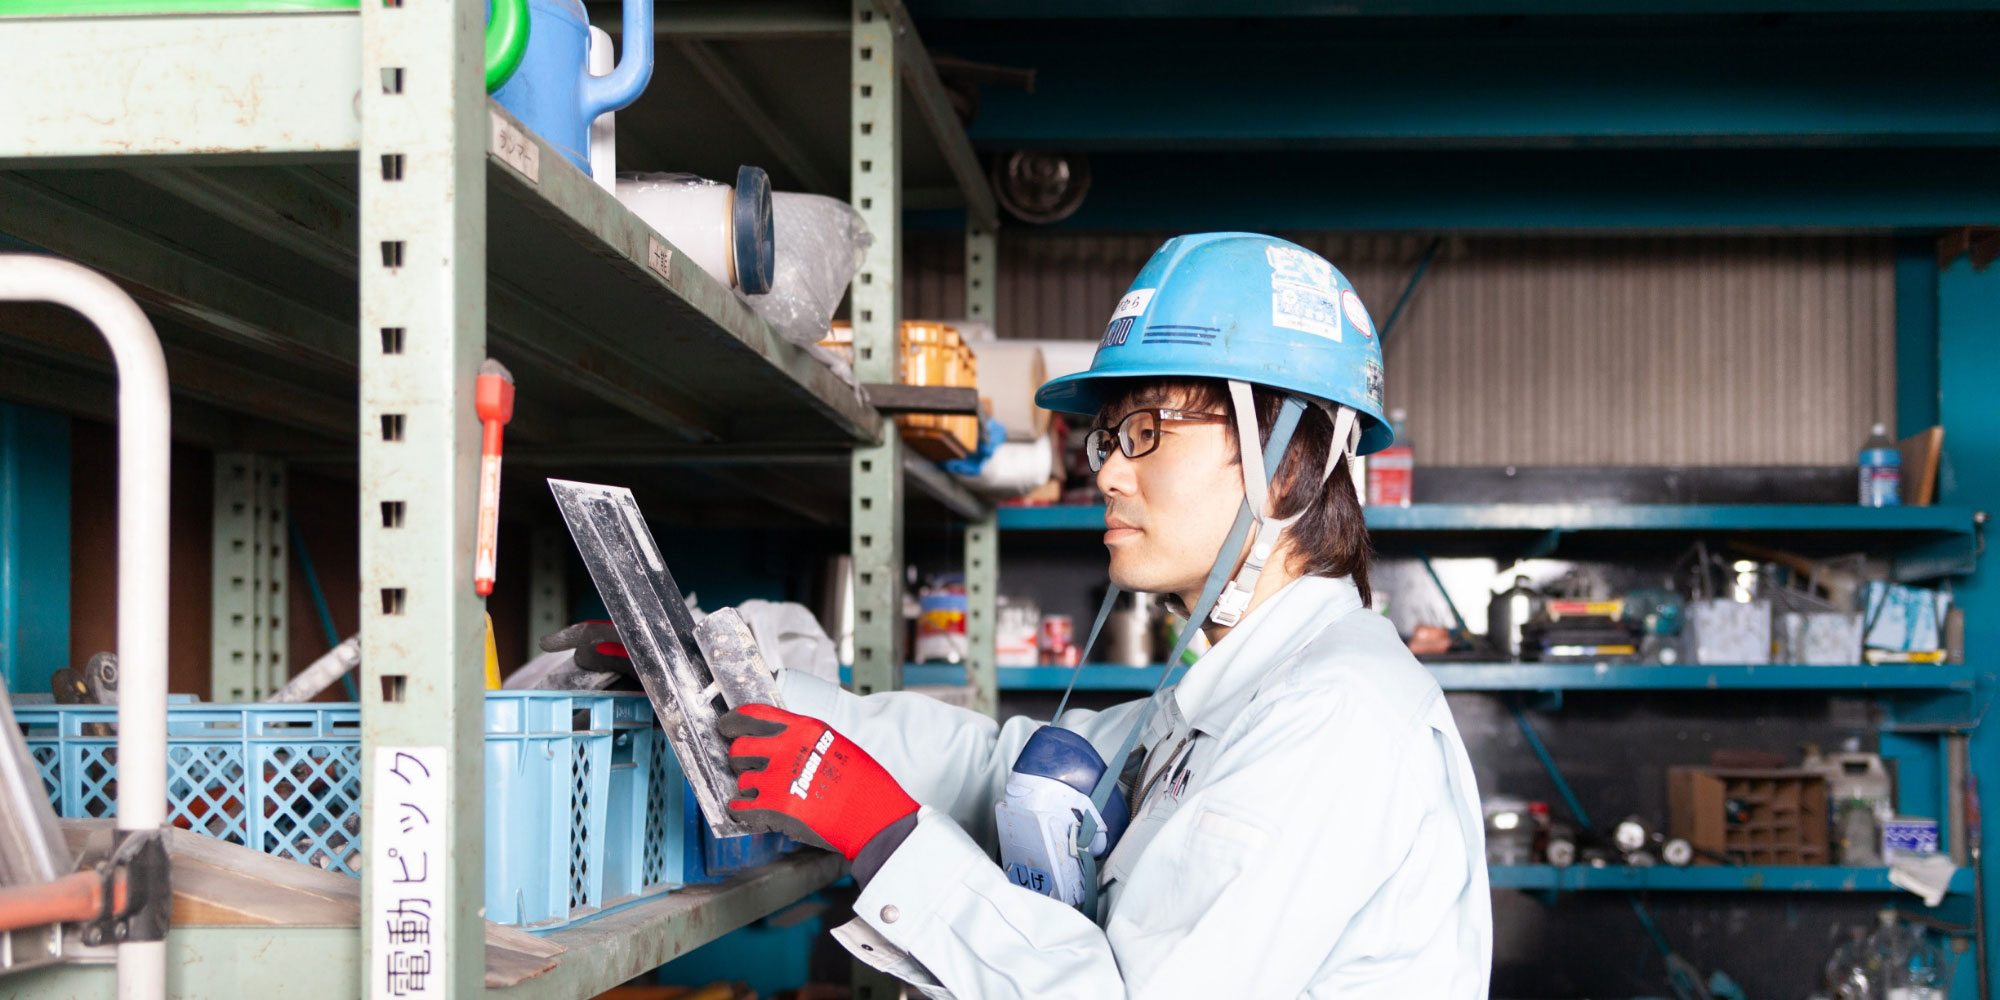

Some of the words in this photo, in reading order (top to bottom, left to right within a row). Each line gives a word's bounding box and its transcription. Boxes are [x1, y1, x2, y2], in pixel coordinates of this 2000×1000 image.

[500, 129, 532, 161] ランマー
[815, 729, 835, 755] RED
[386, 752, 431, 997] 電動ピック
